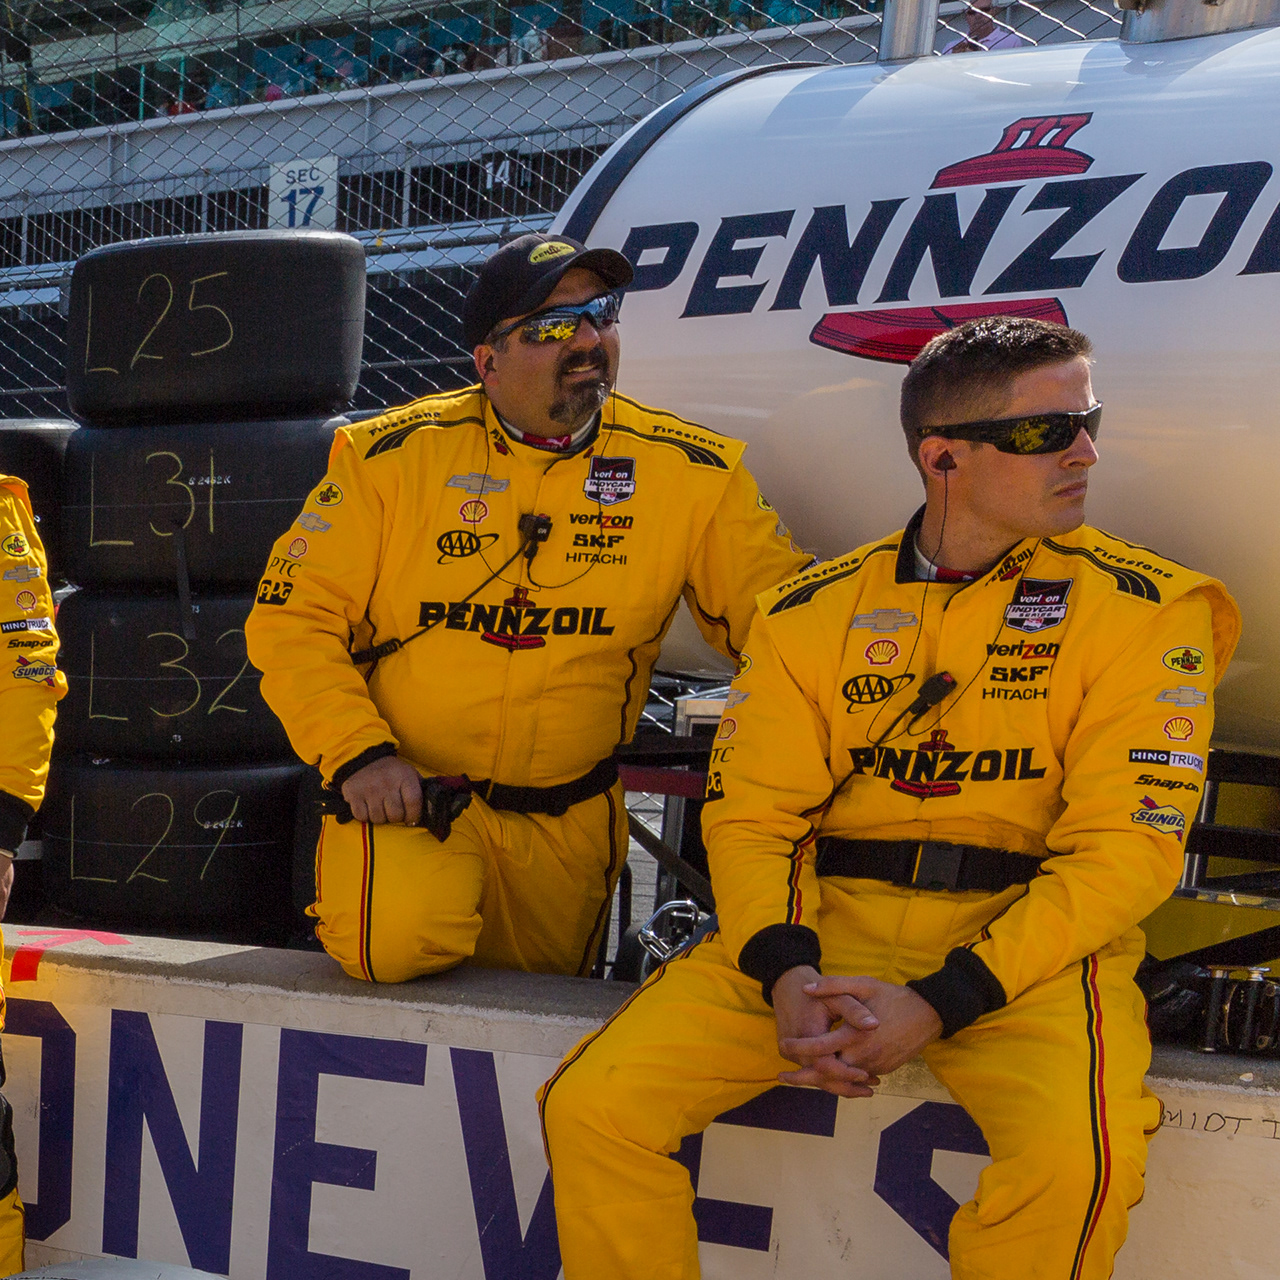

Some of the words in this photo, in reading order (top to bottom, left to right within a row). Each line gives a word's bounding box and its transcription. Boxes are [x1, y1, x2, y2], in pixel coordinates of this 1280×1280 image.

[285, 167, 321, 185] SEC
[280, 185, 325, 228] 17
[85, 271, 234, 375] L25
[368, 411, 441, 437] Firestone
[652, 424, 726, 450] Firestone
[589, 481, 633, 489] INDYCAR
[569, 512, 633, 530] verizon
[443, 533, 475, 555] AAA
[573, 534, 625, 549] SKF
[269, 556, 301, 578] PTC
[566, 552, 627, 566] HITACHI
[1093, 545, 1174, 579] Firestone
[776, 556, 861, 594] Firestone
[257, 580, 293, 604] PPG
[1020, 593, 1060, 604] verizon
[416, 601, 616, 636] PENNZOIL
[1008, 605, 1065, 614] INDYCAR
[2, 622, 27, 631] HINO
[7, 639, 54, 649] Snap-on
[986, 642, 1060, 660] verizon
[1171, 654, 1202, 668] PENNZOIL
[17, 667, 56, 677] SUNOCO
[990, 665, 1049, 683] SKF
[849, 679, 888, 701] AAA
[982, 687, 1048, 701] HITACH
[1131, 751, 1167, 762] HINO
[1135, 774, 1199, 793] Snap-on
[1137, 809, 1186, 830] SUNOC
[71, 789, 241, 883] L29
